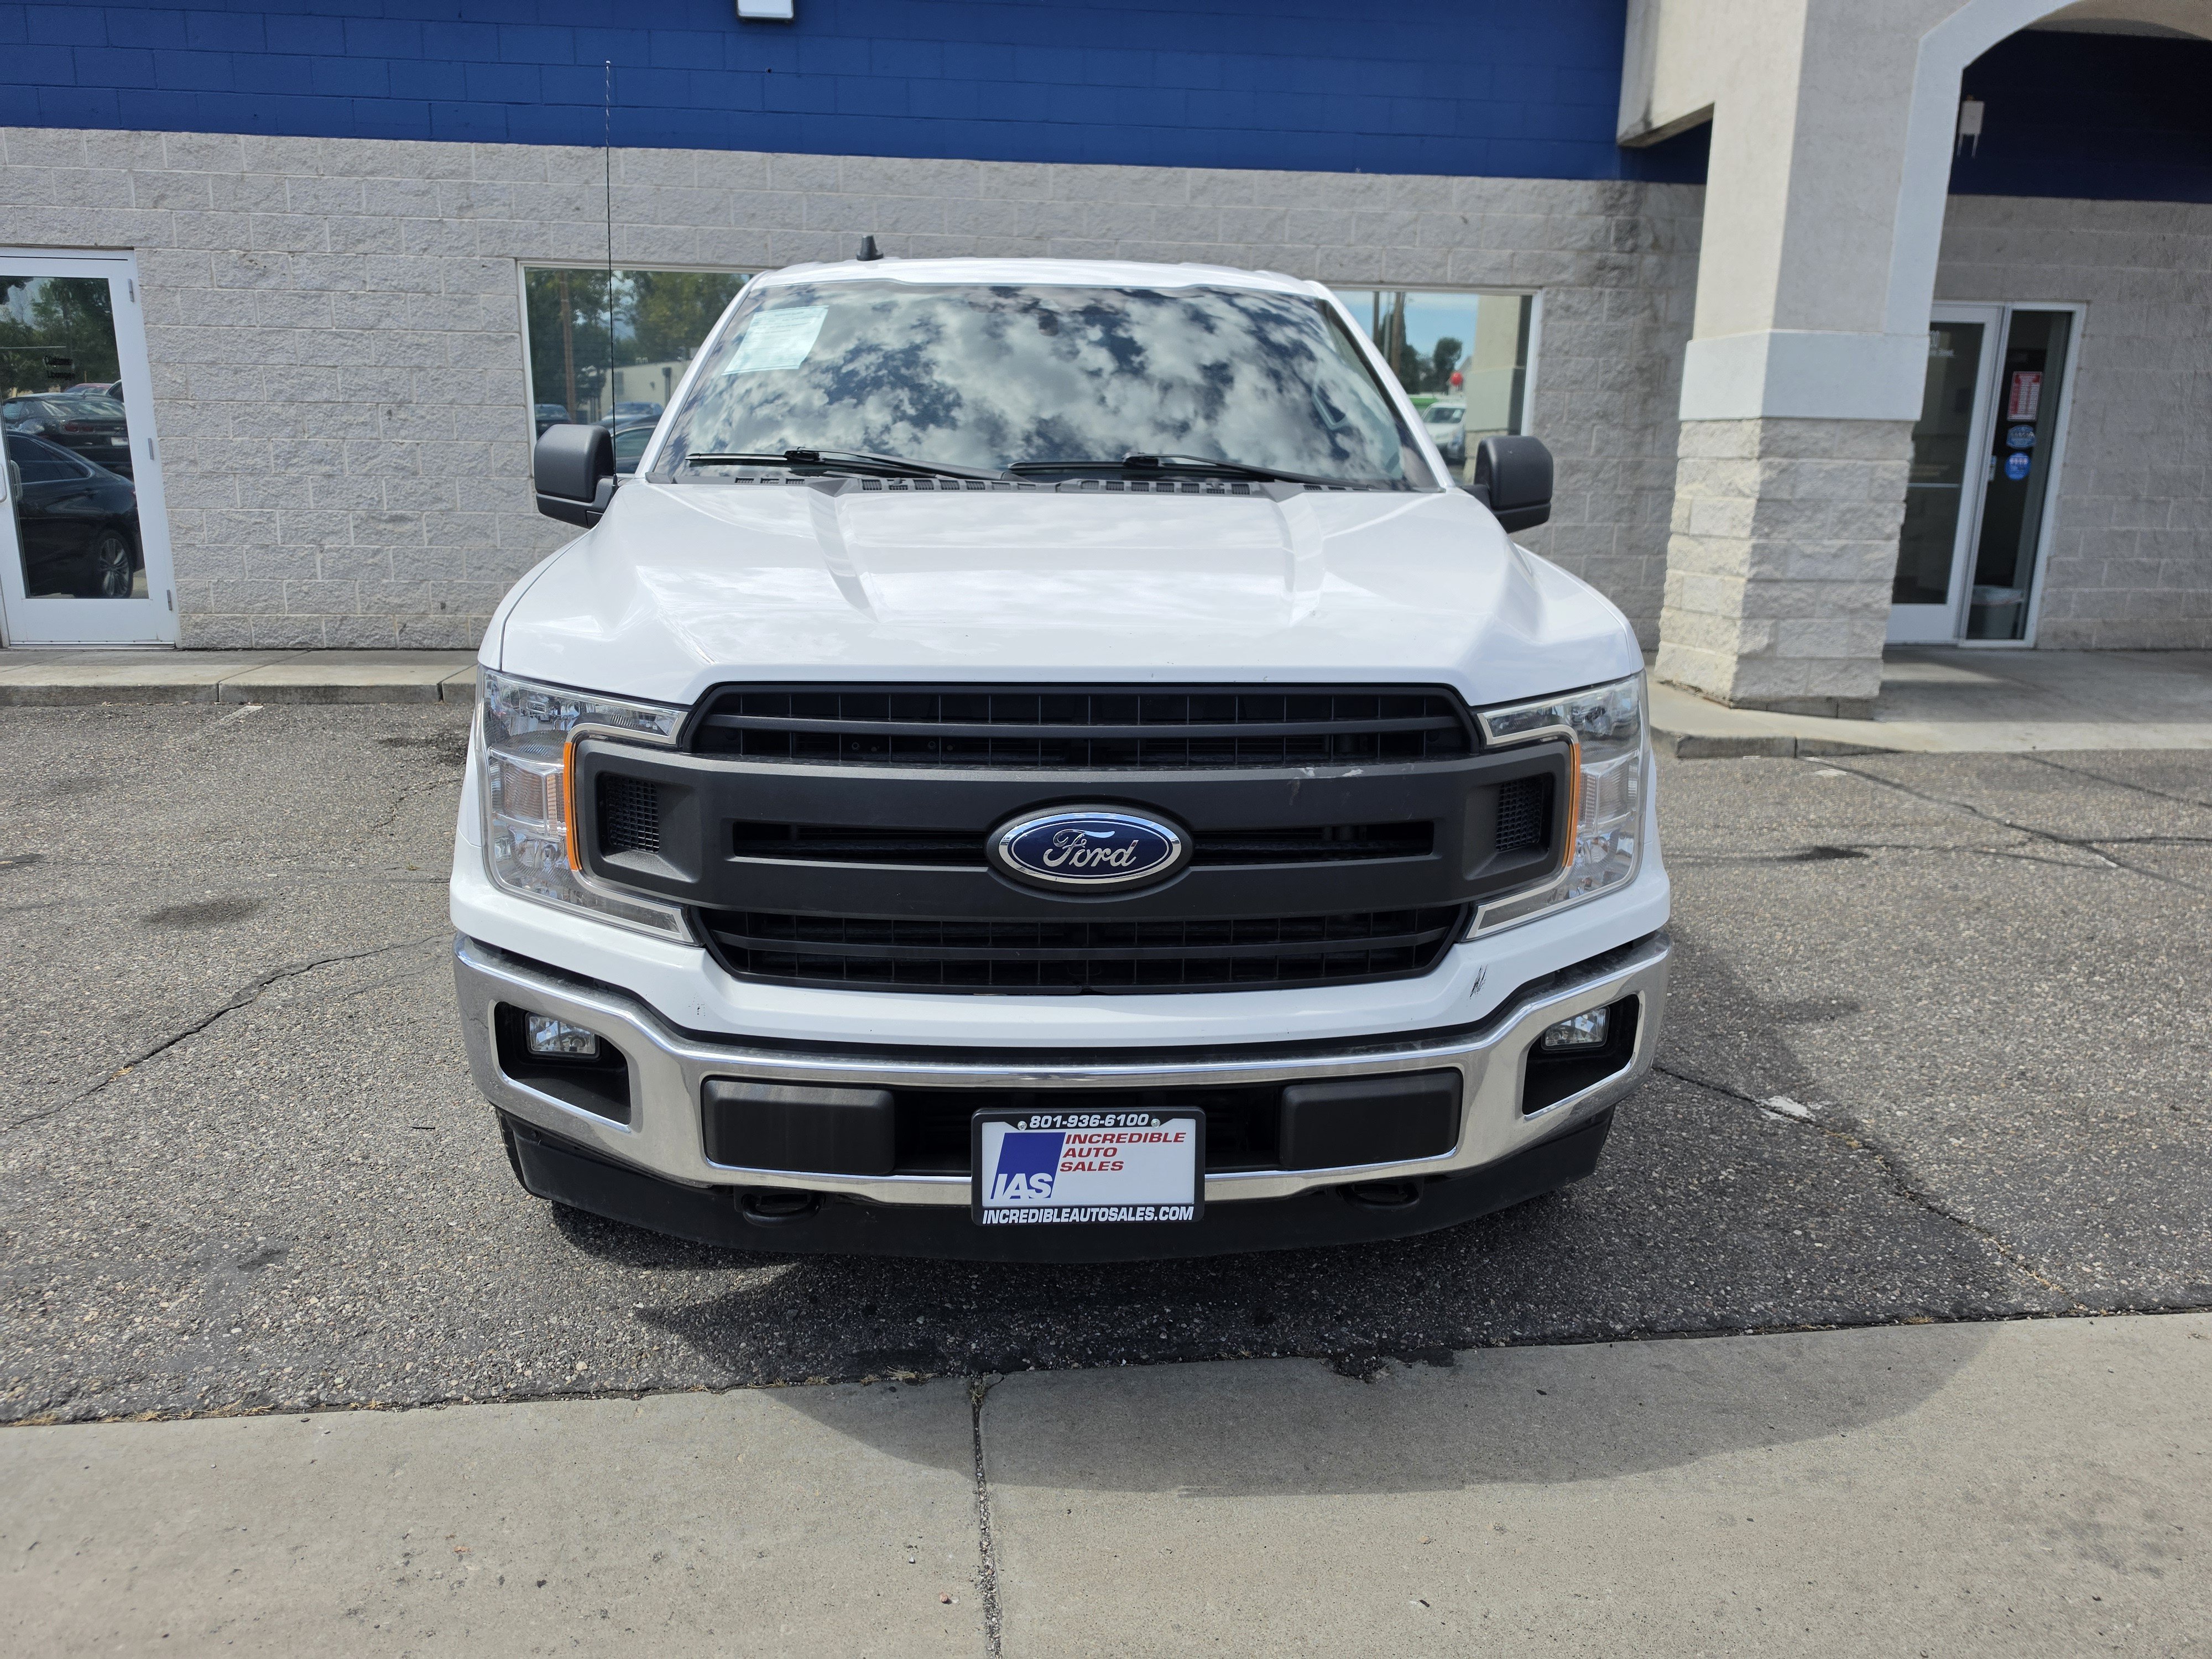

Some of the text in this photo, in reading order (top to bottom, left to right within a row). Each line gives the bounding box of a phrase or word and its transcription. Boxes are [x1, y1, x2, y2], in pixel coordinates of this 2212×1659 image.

[1043, 829, 1139, 867] Ford
[1030, 1114, 1149, 1128] 801-936-6100
[1066, 1132, 1186, 1144] INCREDIBLE
[1063, 1147, 1117, 1159] AUTO
[1060, 1161, 1124, 1172] SALES
[994, 1173, 1053, 1199] IAS
[983, 1207, 1194, 1224] INCREDIBLEAUTOSALES.COM
